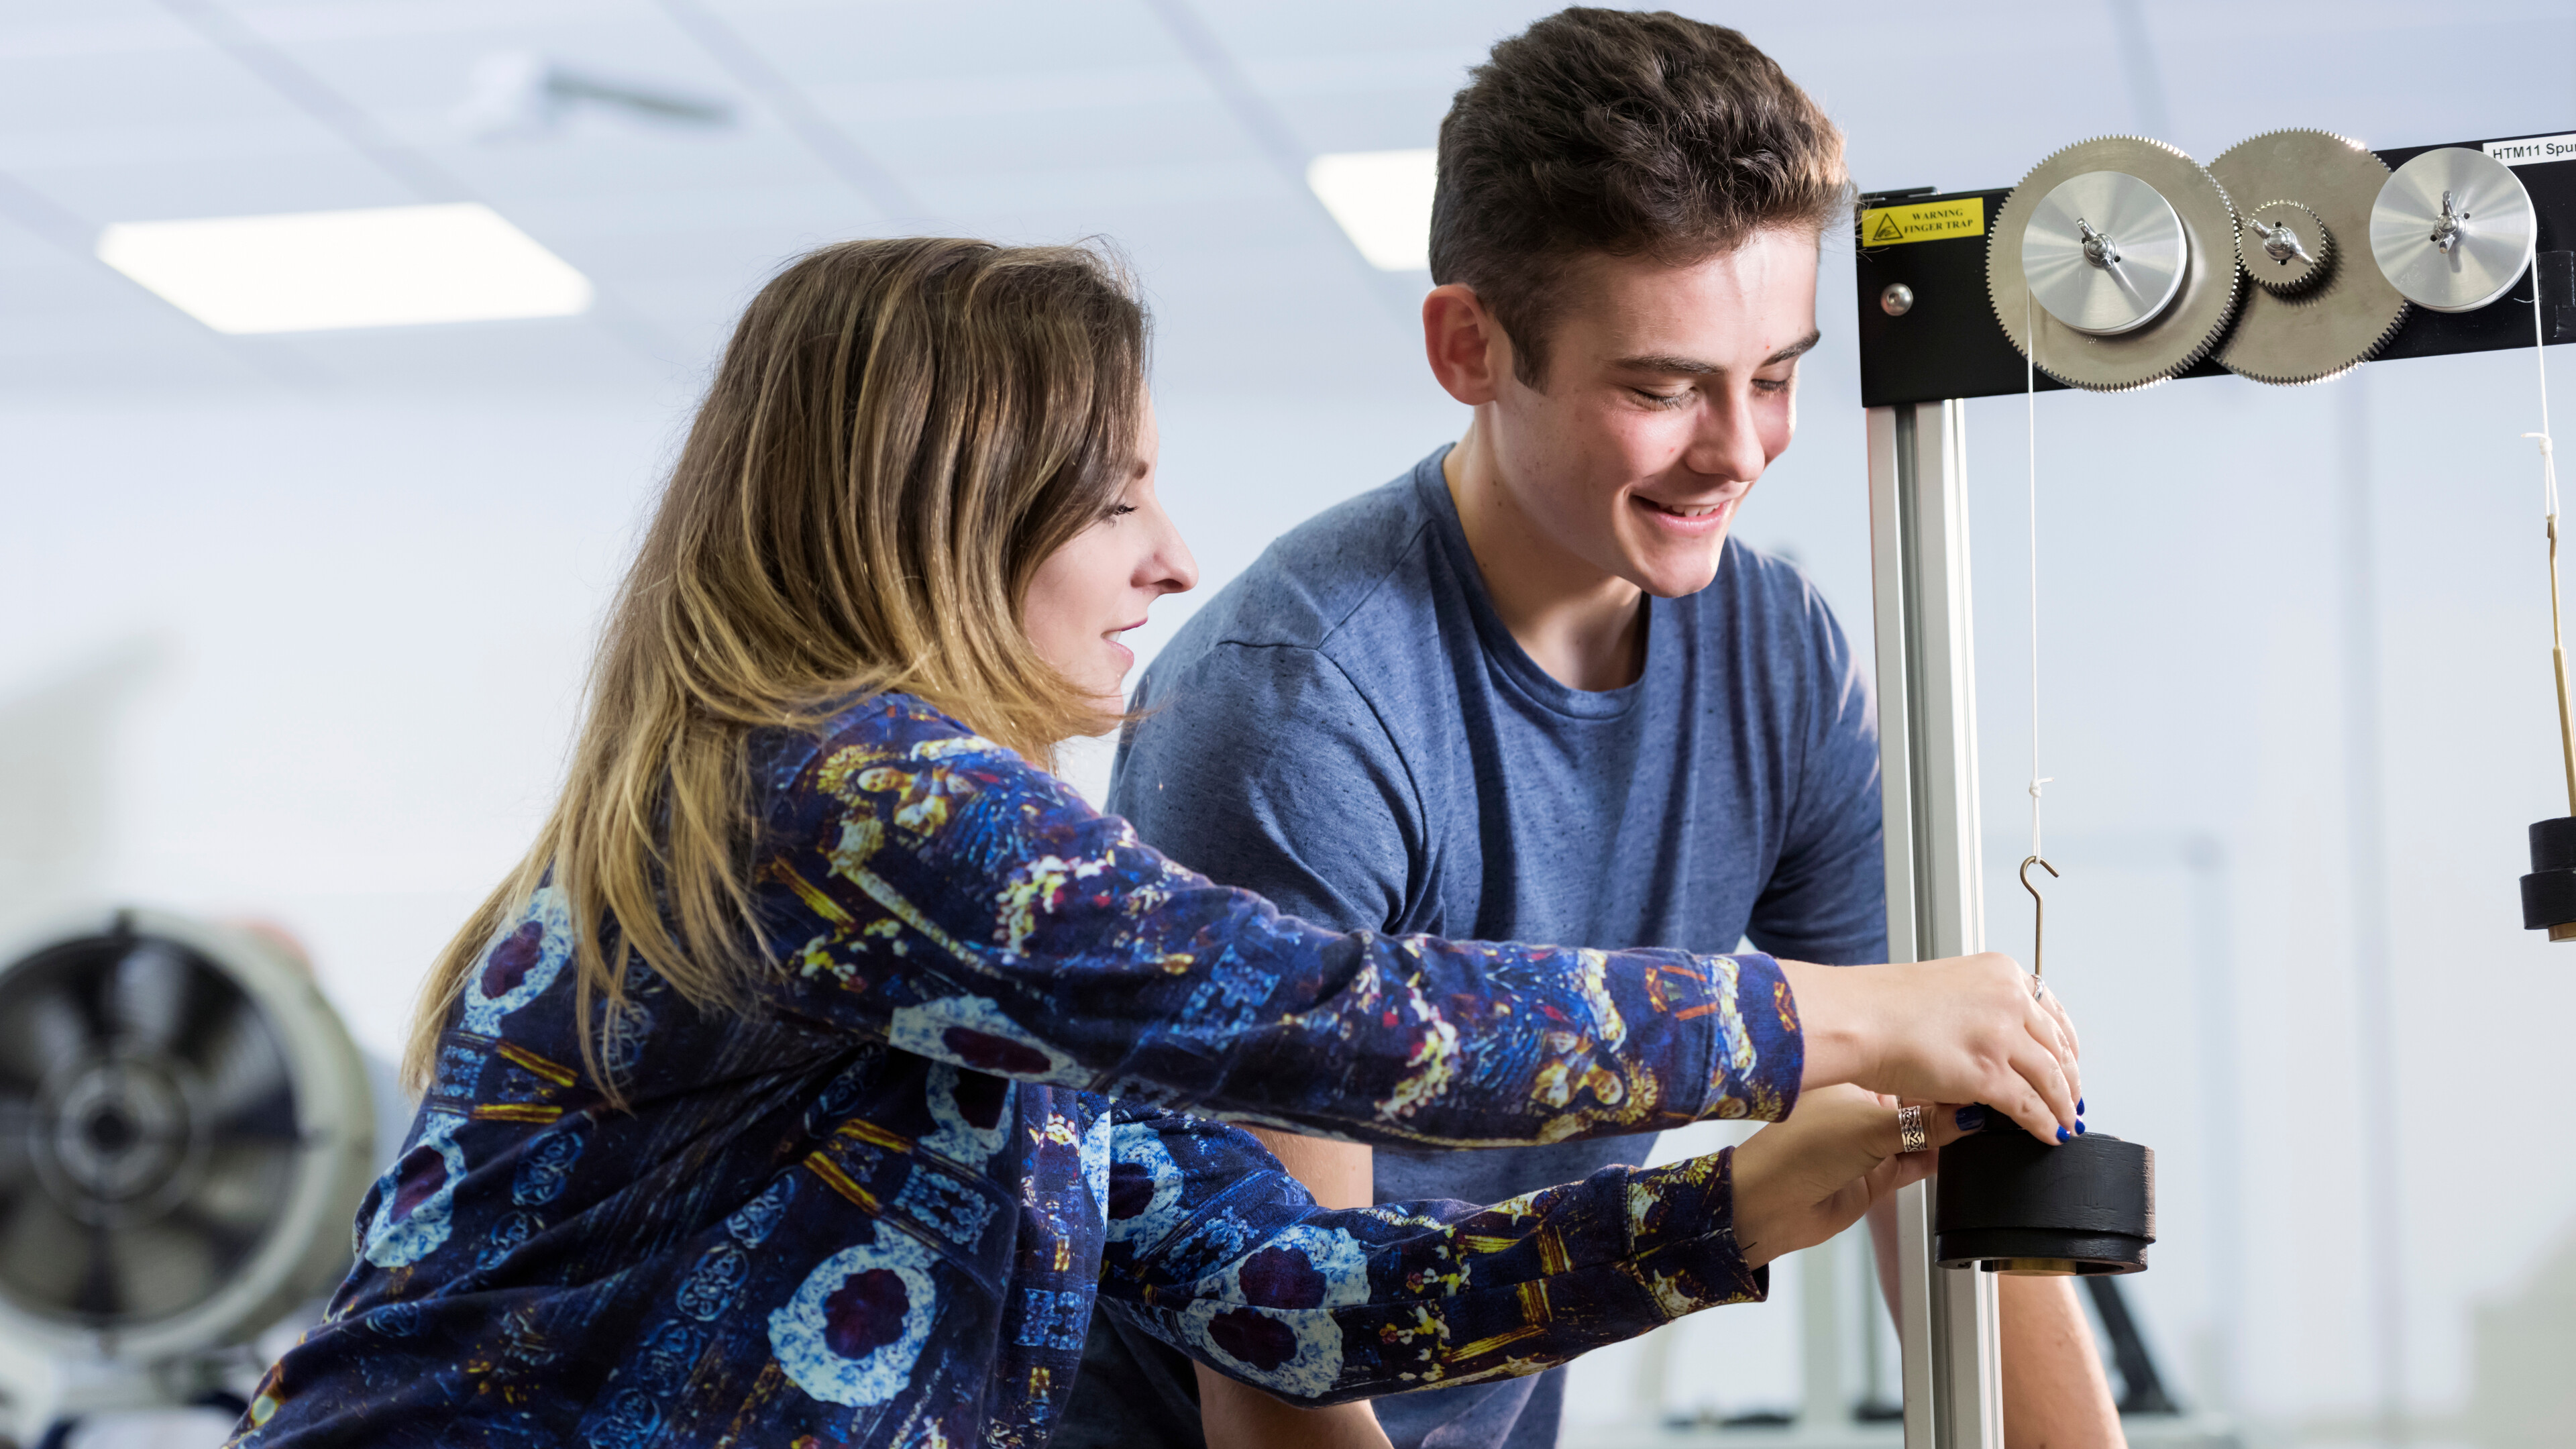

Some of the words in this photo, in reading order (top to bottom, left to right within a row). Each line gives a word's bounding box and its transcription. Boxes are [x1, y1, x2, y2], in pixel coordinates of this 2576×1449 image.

[2493, 145, 2539, 160] HTM11
[1912, 208, 1964, 221] WARNING
[1904, 221, 1943, 233] FINGER
[1946, 219, 1974, 229] TRAP
